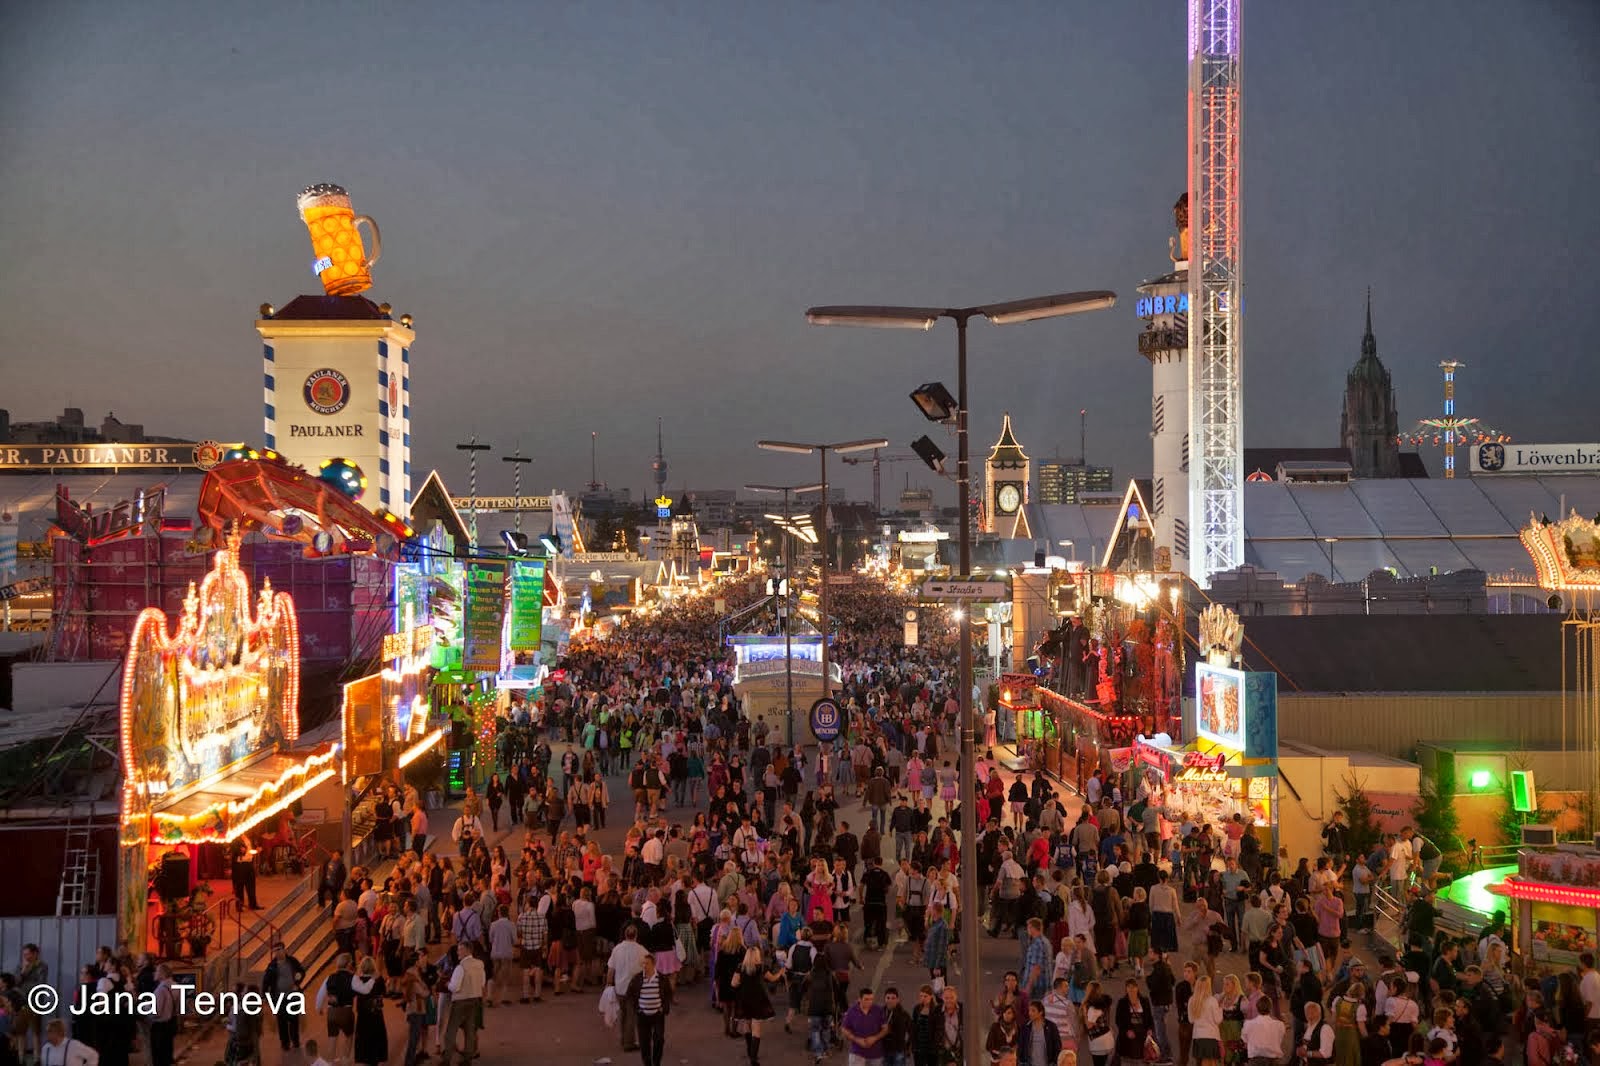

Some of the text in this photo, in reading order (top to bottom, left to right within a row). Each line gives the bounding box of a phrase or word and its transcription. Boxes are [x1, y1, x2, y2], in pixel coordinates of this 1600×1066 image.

[1136, 293, 1188, 317] ENBRÄ
[306, 370, 347, 387] PAULANER
[309, 401, 344, 415] MÜNCHEN
[290, 424, 363, 437] PAULANER
[0, 449, 29, 465] R,
[947, 585, 976, 594] Straße
[821, 714, 833, 723] HB
